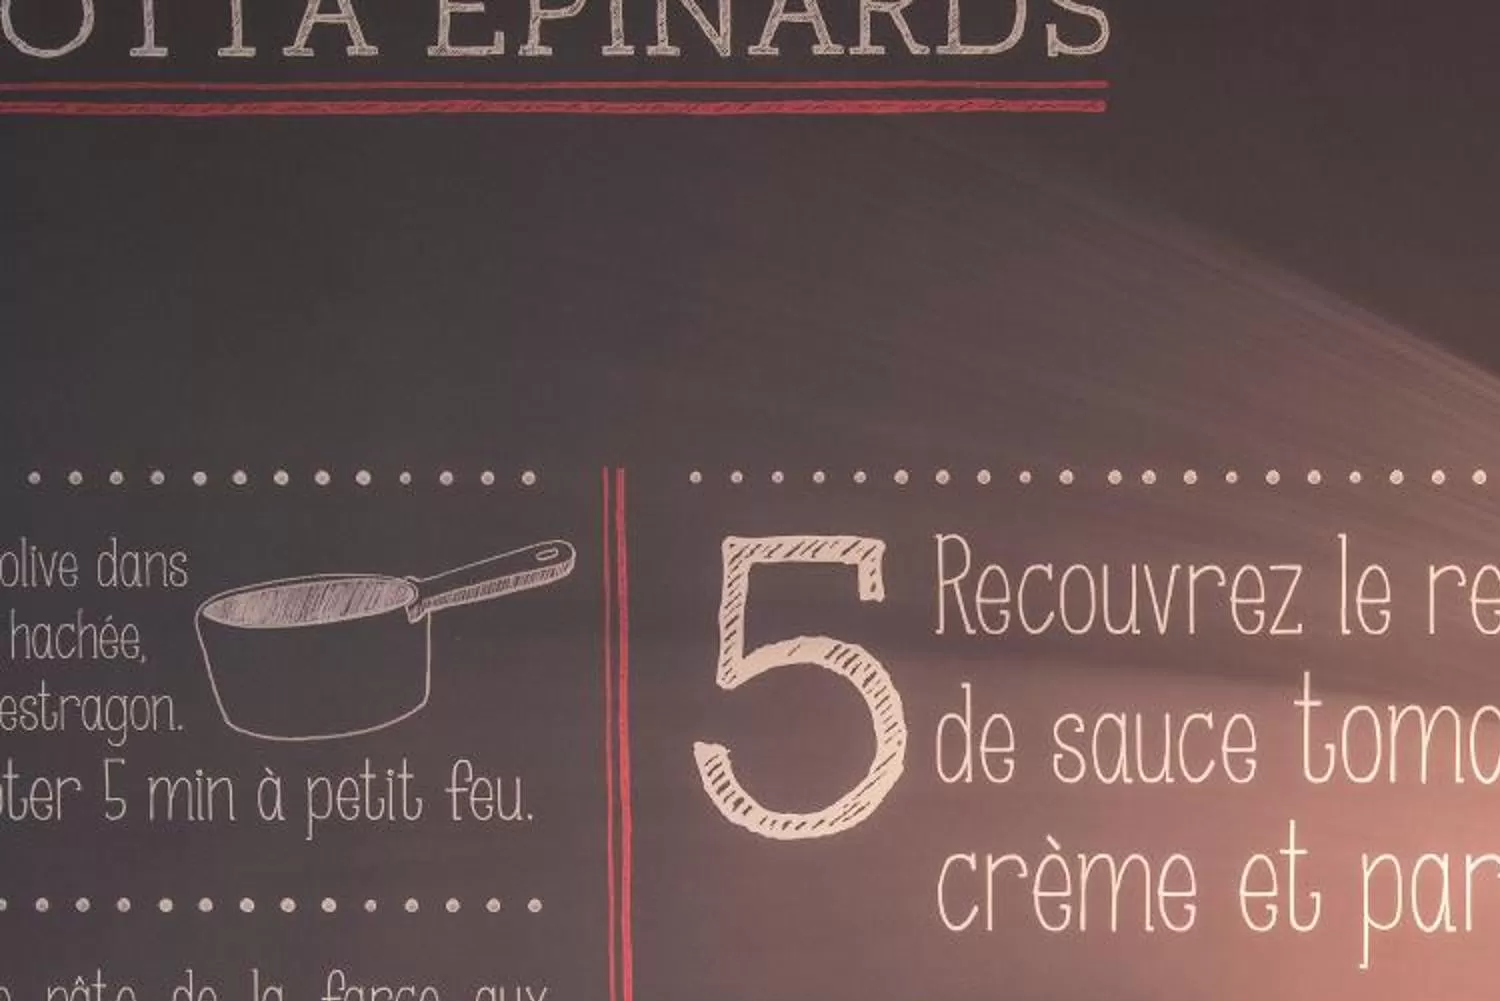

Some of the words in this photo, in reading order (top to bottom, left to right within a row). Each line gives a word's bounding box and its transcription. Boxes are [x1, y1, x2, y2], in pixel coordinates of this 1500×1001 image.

[97, 536, 188, 588] dans
[935, 533, 1303, 635] Recouvrez
[1337, 533, 1391, 635] le
[10, 607, 147, 664] hachée,
[0, 679, 184, 747] estragon.
[693, 535, 908, 840] 5
[935, 683, 1015, 784] de
[1052, 712, 1257, 784] sauce
[0, 757, 81, 822] ter
[104, 757, 126, 822] 5
[148, 769, 236, 822] min
[257, 767, 284, 822] à
[306, 758, 422, 840] petit
[445, 758, 534, 822] feu.
[937, 834, 1197, 931] crème
[1239, 819, 1321, 933] et
